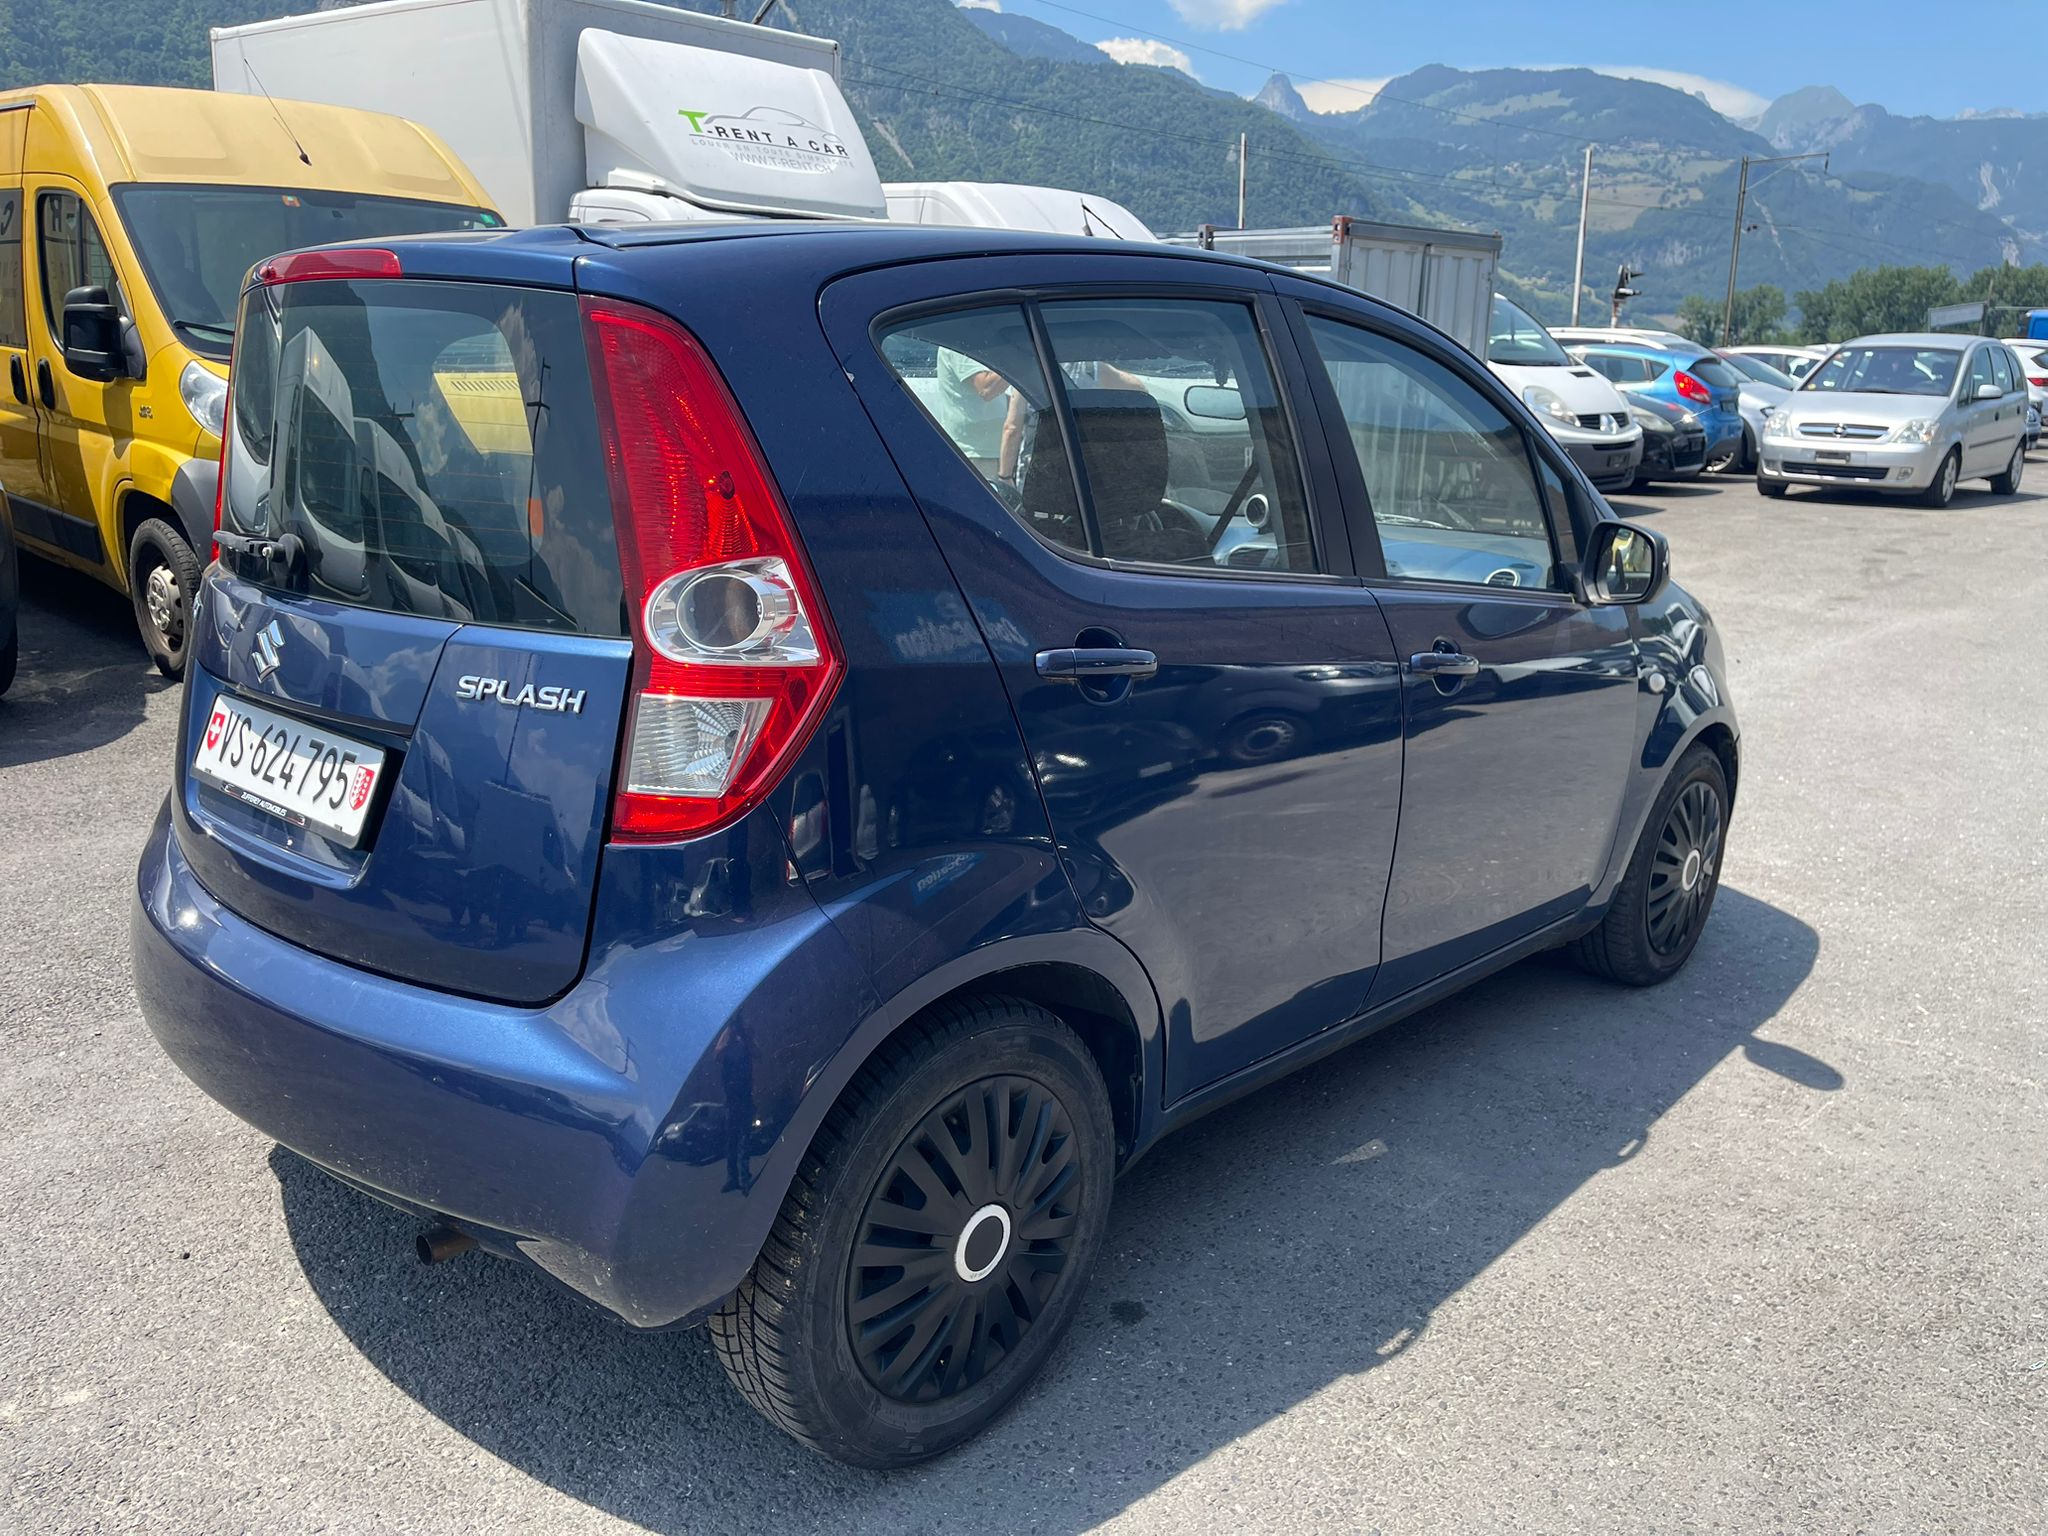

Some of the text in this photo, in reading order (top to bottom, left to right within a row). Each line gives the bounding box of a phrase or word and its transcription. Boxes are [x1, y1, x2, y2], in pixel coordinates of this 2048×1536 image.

[678, 109, 849, 157] T-RENT A CAR
[731, 152, 833, 173] WWW.T-RENT.CH
[456, 674, 587, 715] SPLASH
